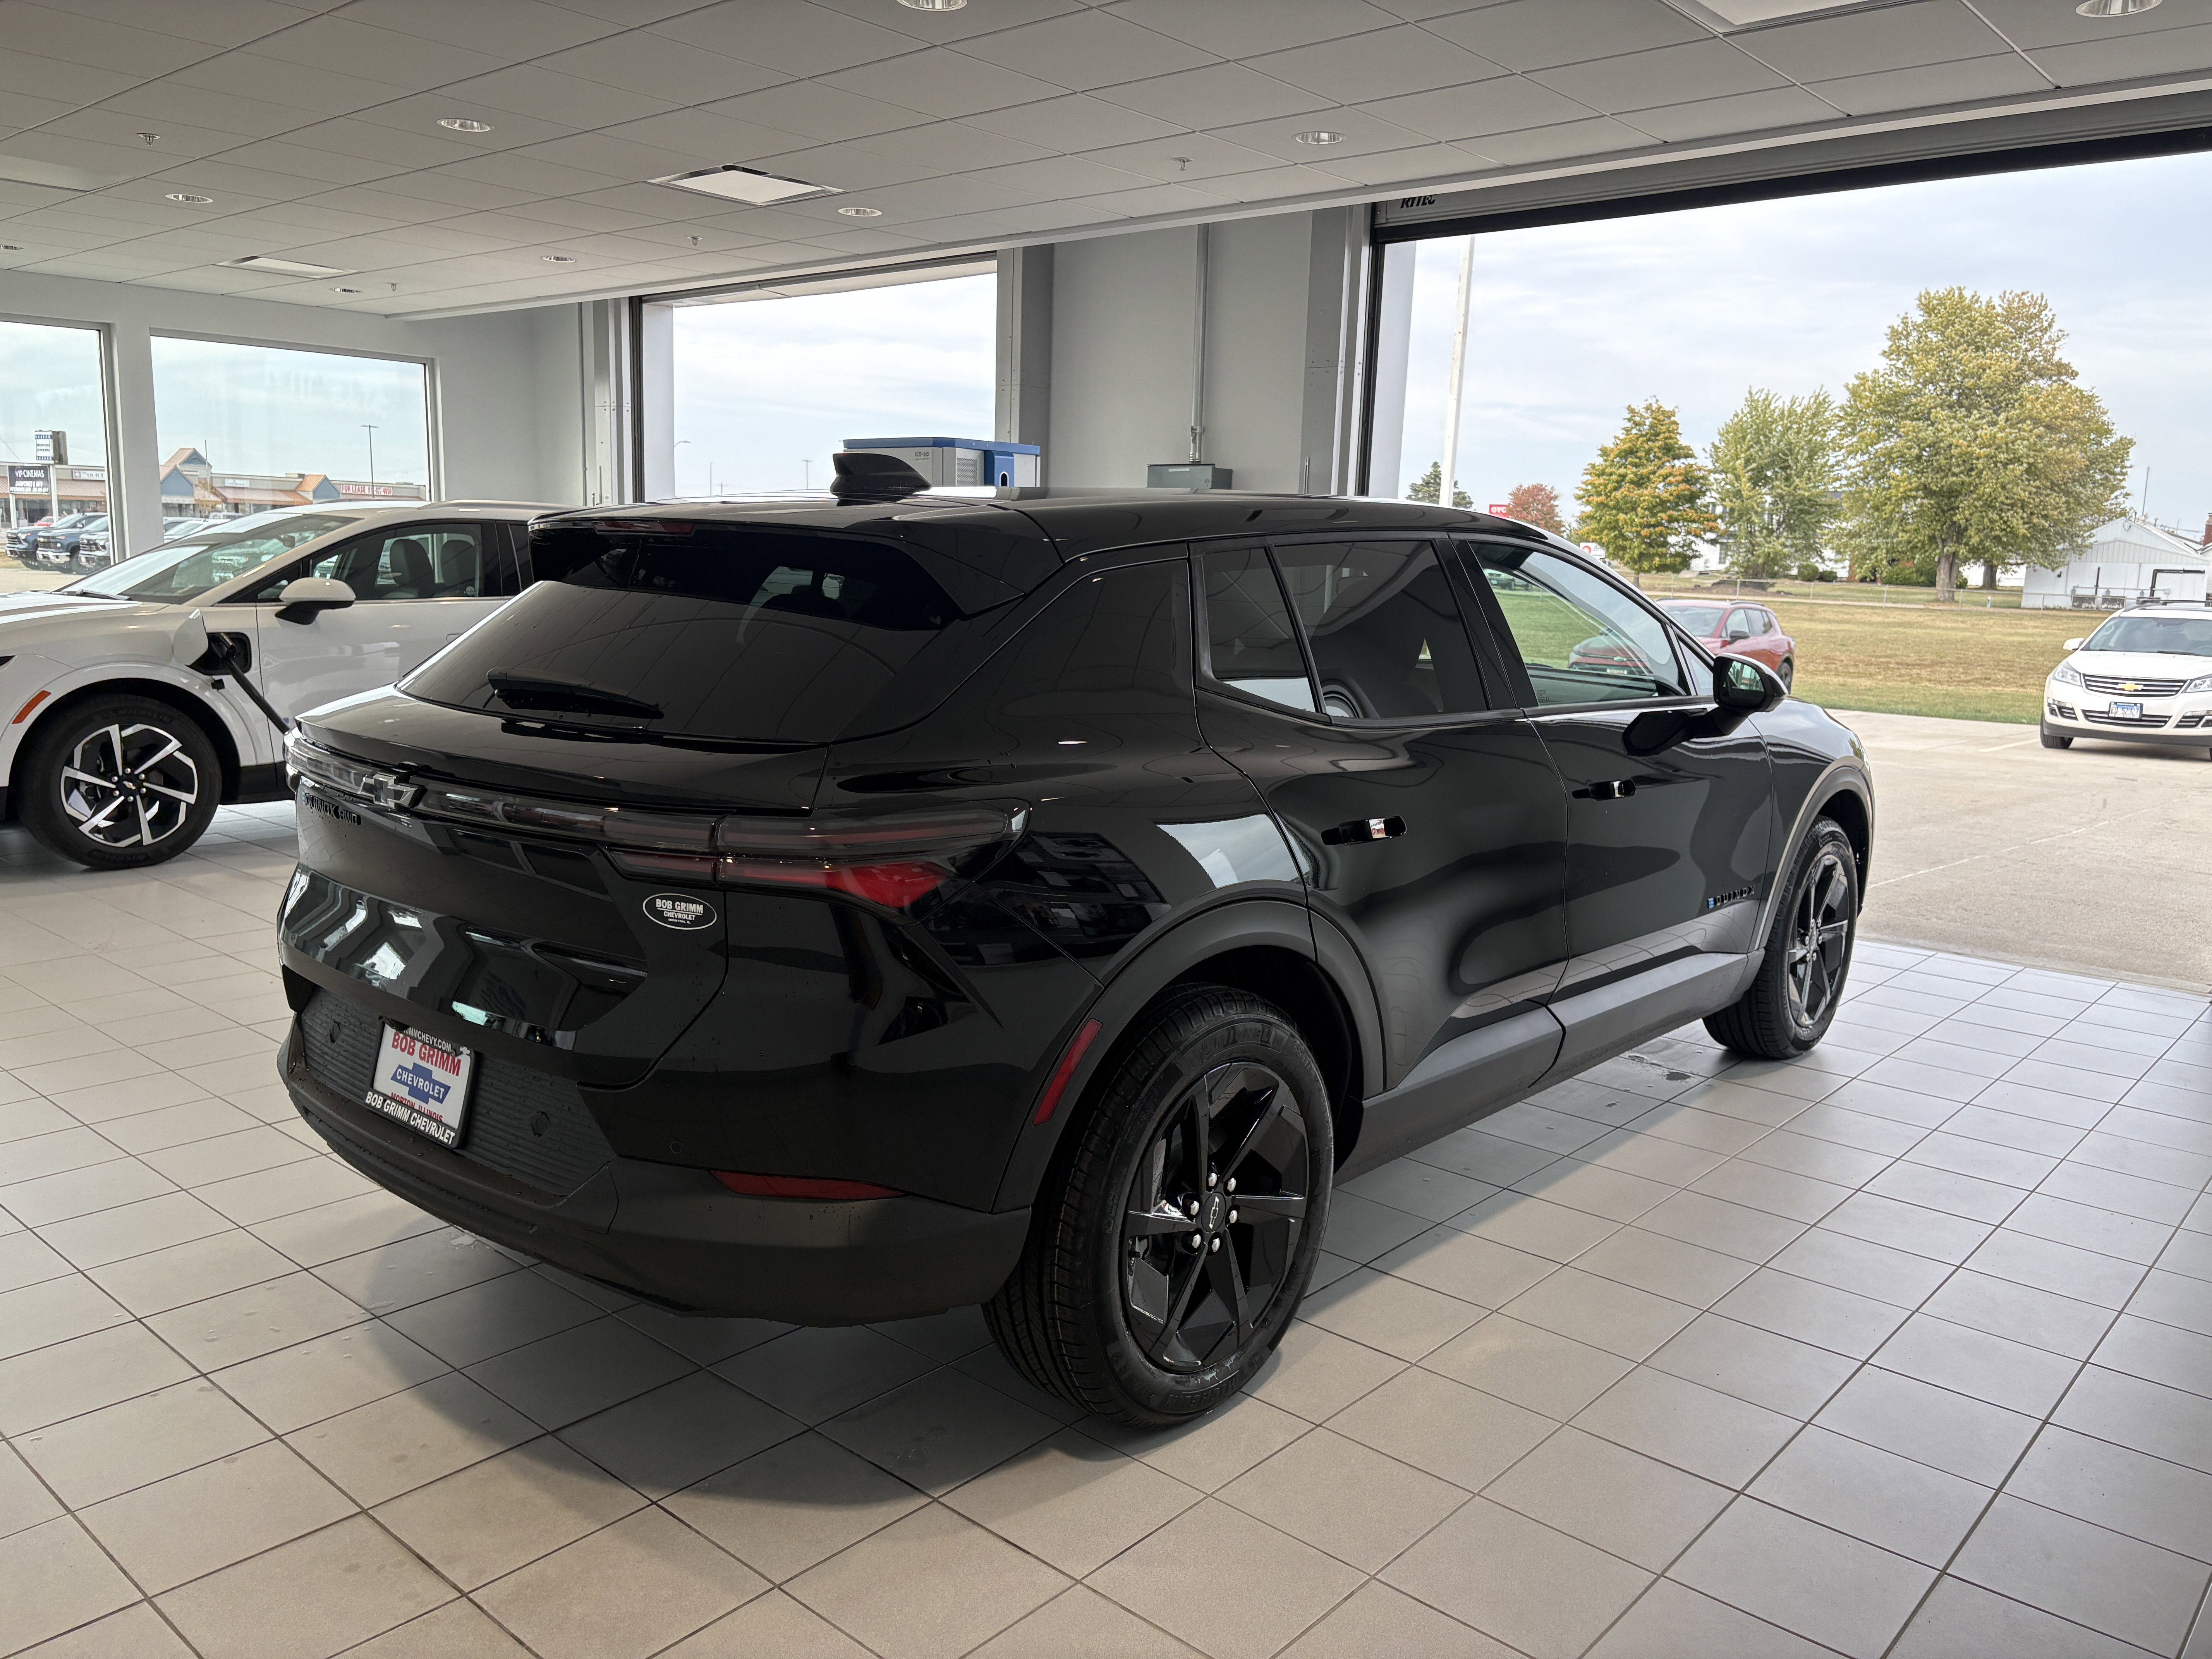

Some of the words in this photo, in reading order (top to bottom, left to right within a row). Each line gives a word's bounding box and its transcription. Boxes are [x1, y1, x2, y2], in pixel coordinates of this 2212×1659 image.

[23, 469, 45, 478] CINEMAS
[302, 791, 339, 819] EQUINOX
[656, 898, 673, 909] BOB
[675, 902, 703, 914] GRIMM
[1707, 885, 1755, 909] EQUINOX
[663, 911, 696, 921] CHEVROLET
[1214, 1026, 1285, 1051] MICHELIN
[392, 1031, 416, 1056] BOB
[419, 1043, 462, 1077] GRIMM
[397, 1068, 445, 1099] CHEVROLET
[365, 1091, 384, 1109] BOB
[384, 1099, 411, 1122] GRIMM
[410, 1112, 455, 1145] CHEVROLET
